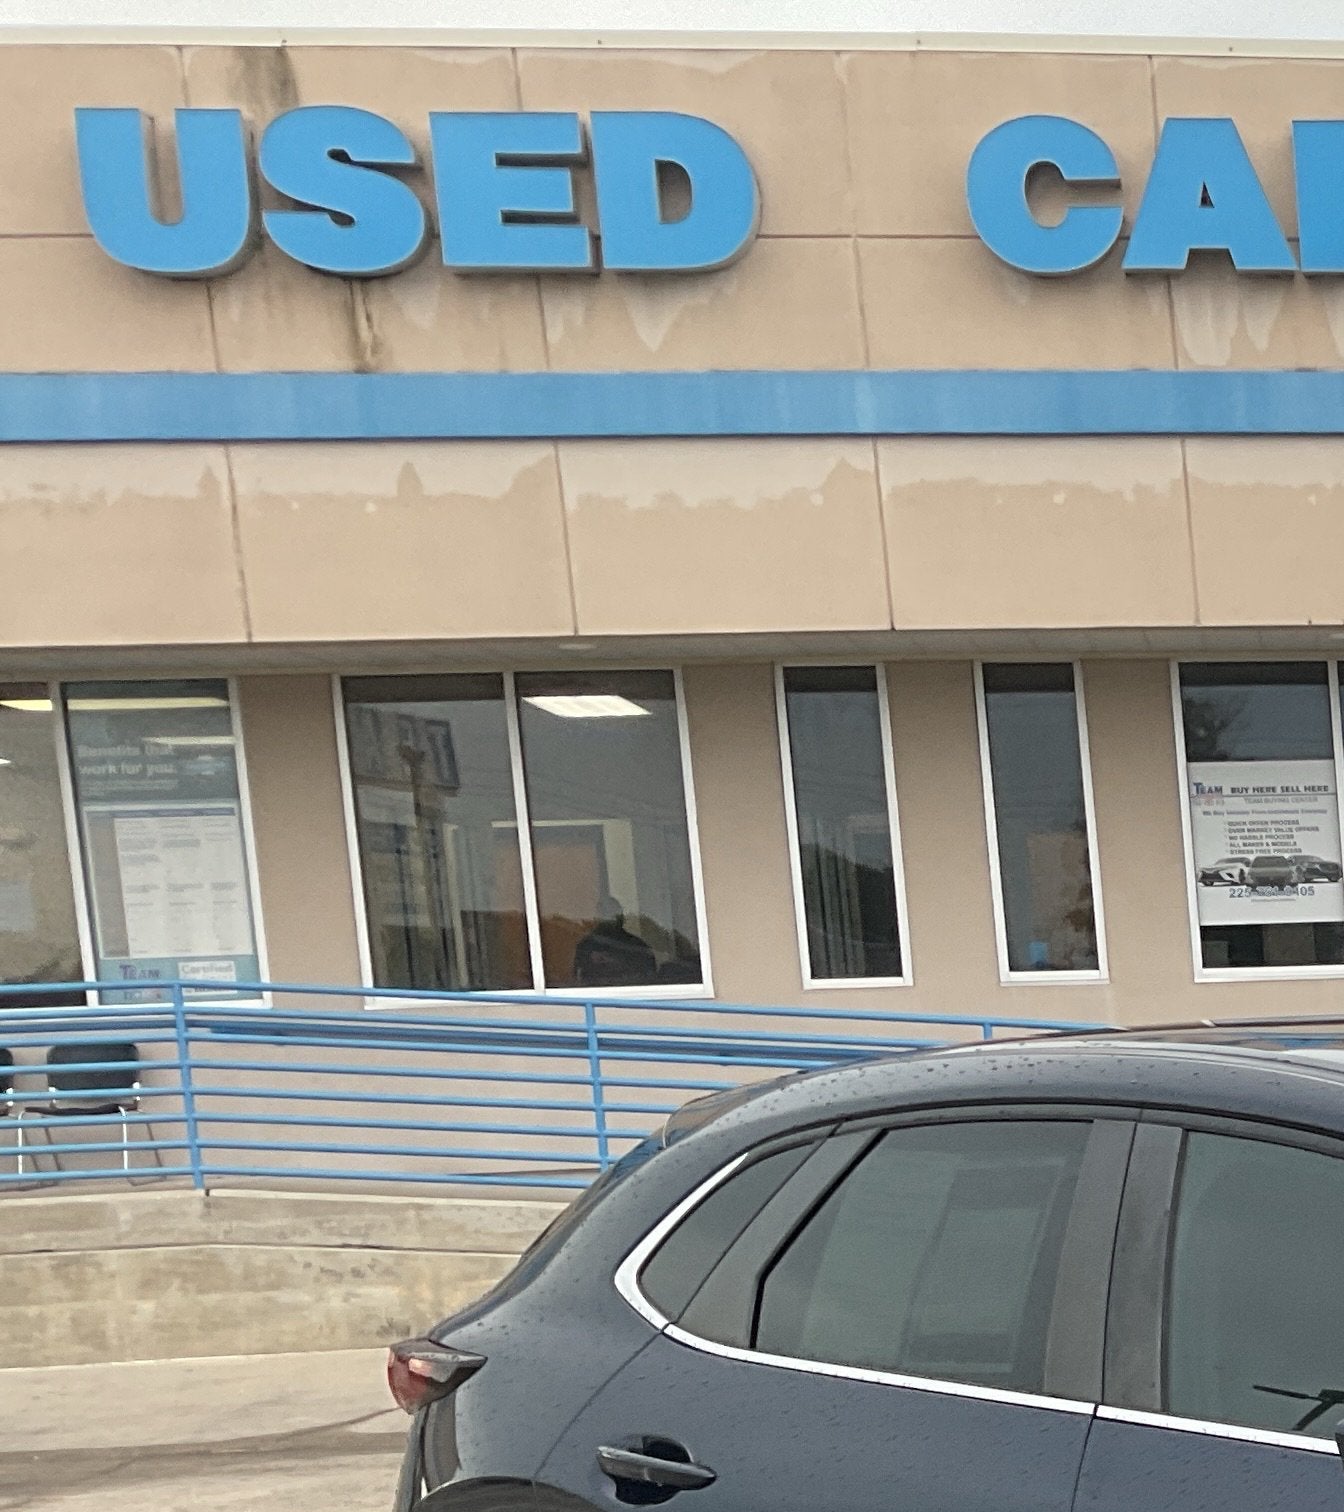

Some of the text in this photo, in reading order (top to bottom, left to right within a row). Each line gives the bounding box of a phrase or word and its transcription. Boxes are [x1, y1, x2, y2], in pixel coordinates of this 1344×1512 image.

[74, 105, 761, 278] USED
[1231, 786, 1249, 794] BUY
[1280, 785, 1301, 793] SELL
